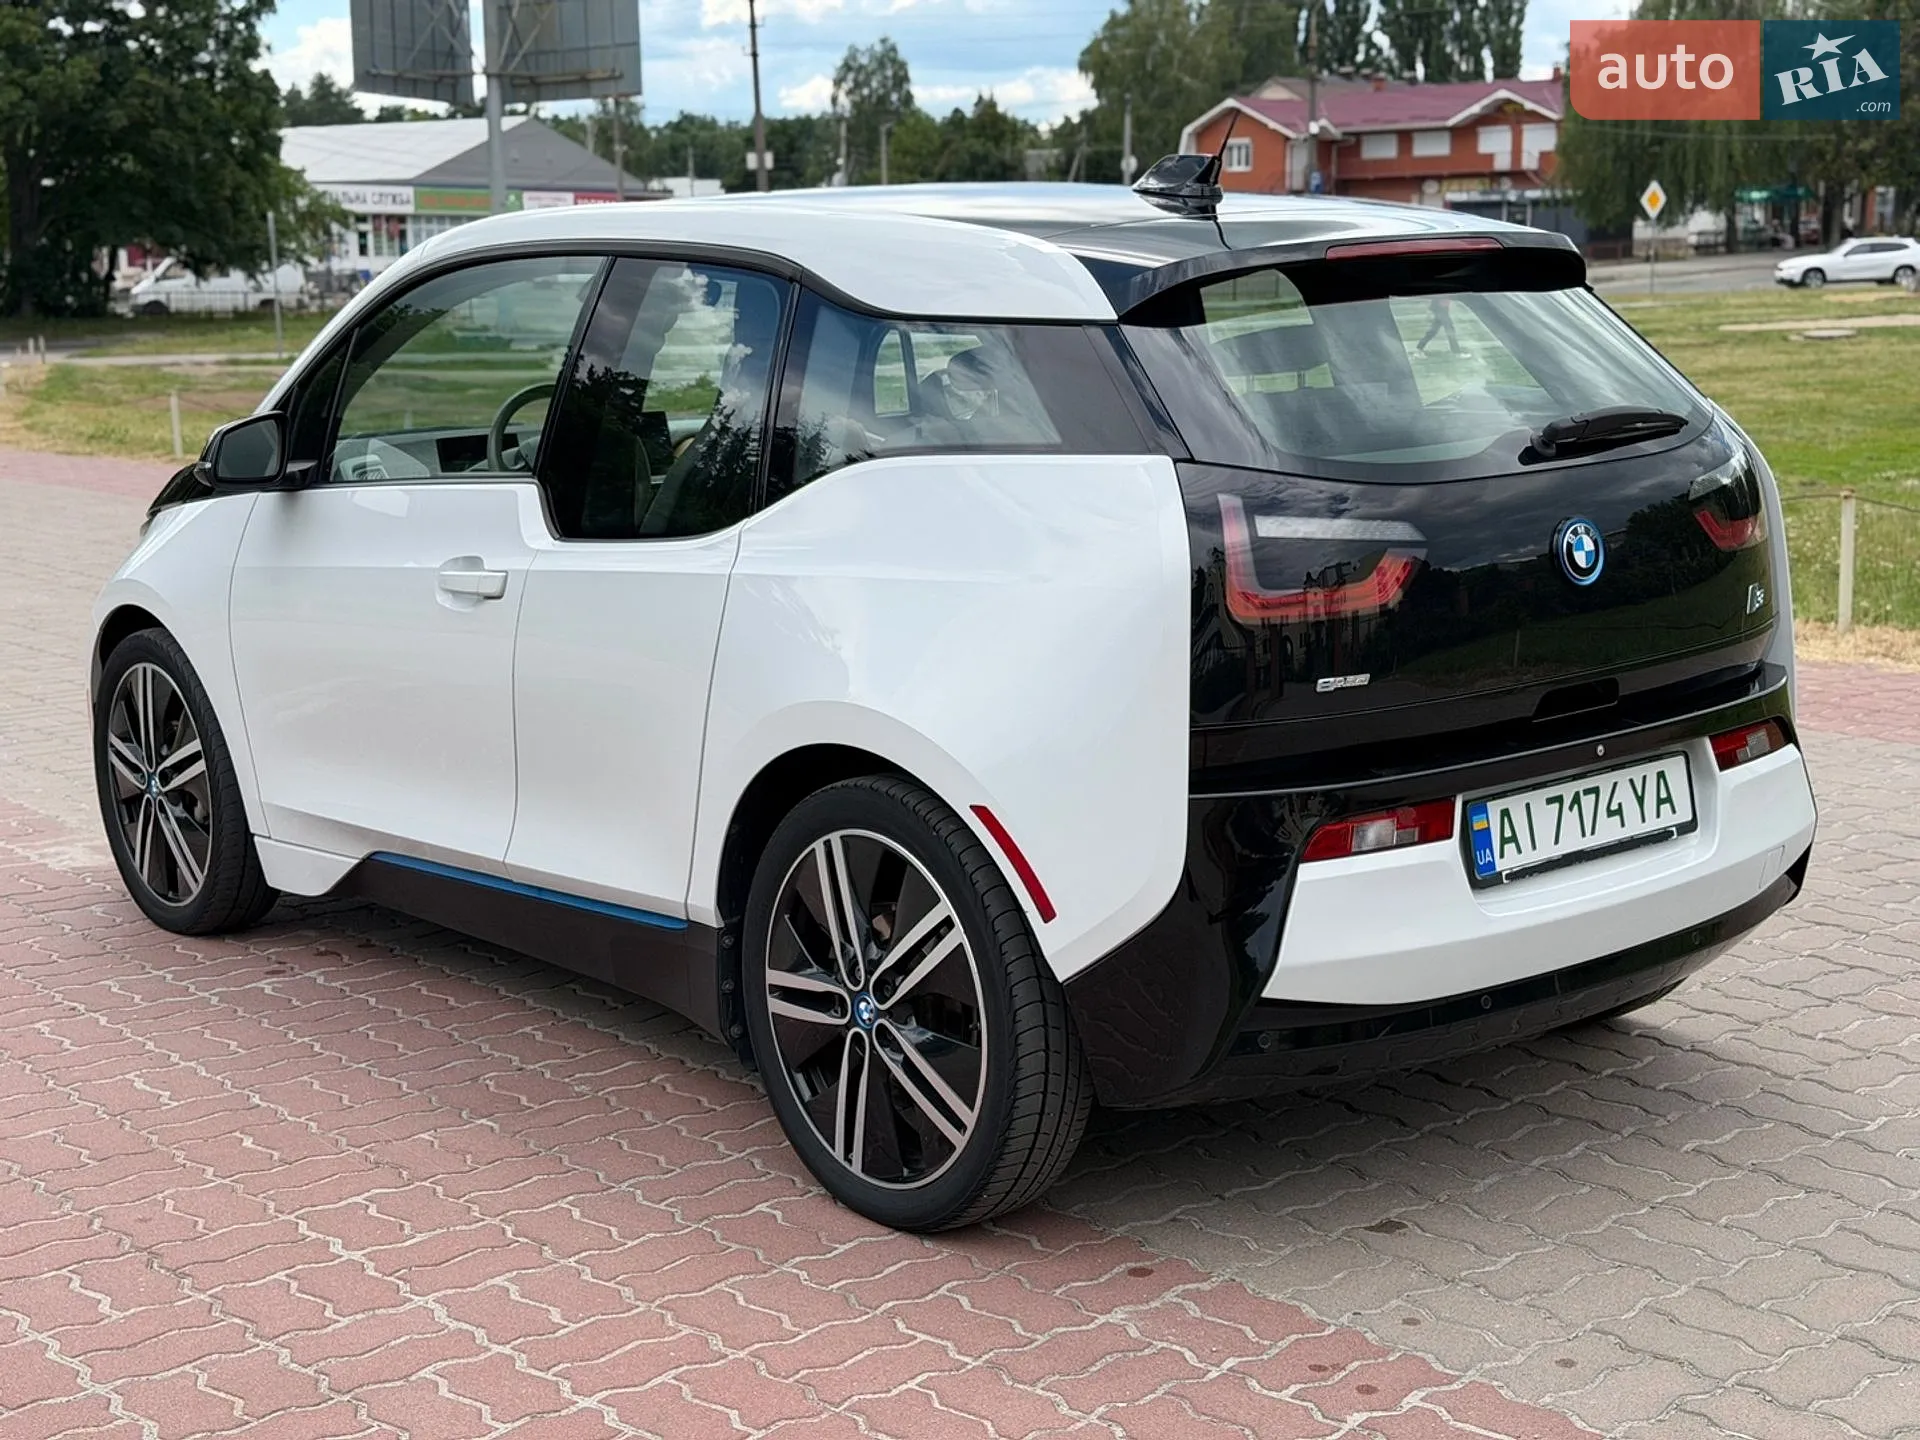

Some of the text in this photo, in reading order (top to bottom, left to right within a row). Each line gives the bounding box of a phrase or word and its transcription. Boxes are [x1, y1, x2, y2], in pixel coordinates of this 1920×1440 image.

[1567, 525, 1598, 544] BMW
[1499, 769, 1677, 860] AI 7174 YA
[1475, 849, 1494, 866] UA
